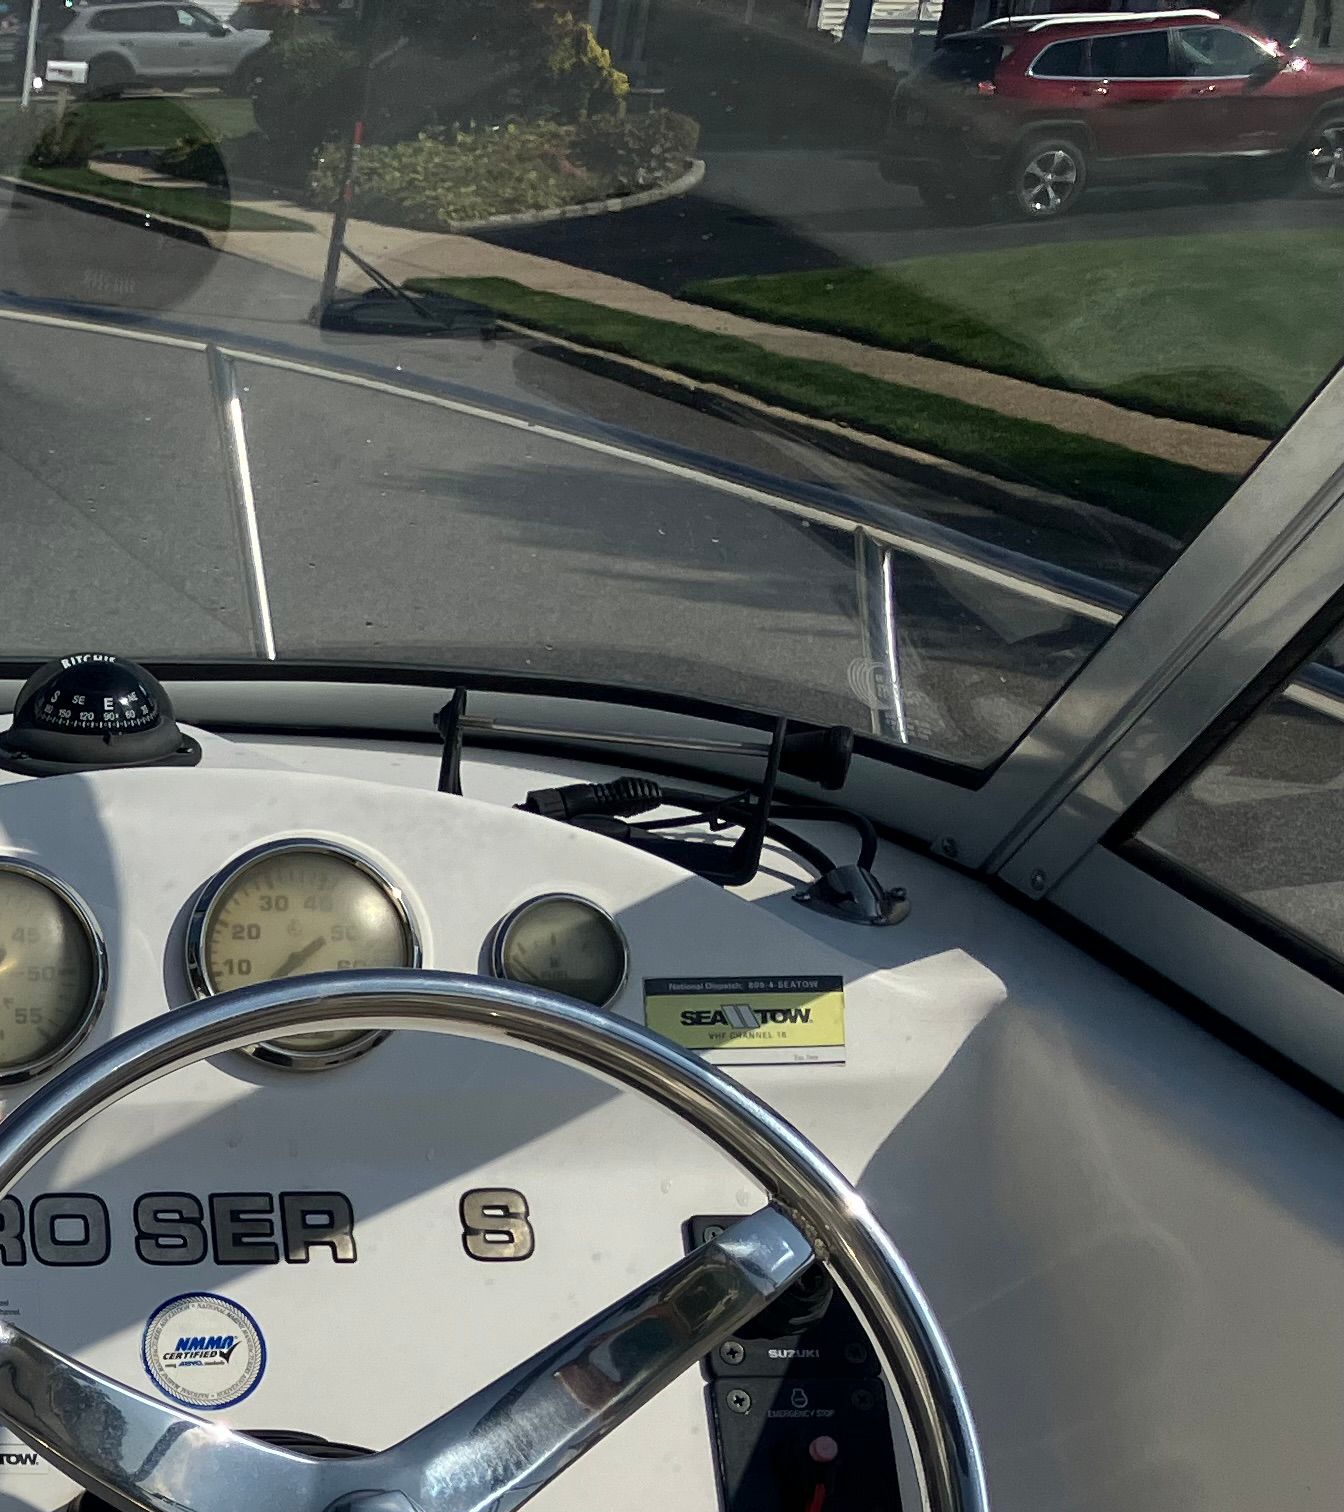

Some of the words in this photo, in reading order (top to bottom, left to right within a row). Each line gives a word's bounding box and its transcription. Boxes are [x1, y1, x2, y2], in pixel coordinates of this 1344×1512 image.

[51, 690, 61, 703] S
[72, 694, 86, 705] SE
[103, 697, 114, 710] E
[79, 712, 94, 720] 120
[259, 895, 289, 912] 30
[13, 928, 41, 945] 45
[231, 923, 261, 941] 20
[26, 965, 56, 982] 50
[225, 959, 252, 975] 10
[14, 1007, 44, 1025] 55
[680, 1009, 729, 1026] SEA
[754, 1008, 811, 1025] TOW
[708, 1031, 726, 1040] VHF
[729, 1030, 773, 1039] CHANNEL
[175, 1335, 234, 1351] NMMA
[163, 1350, 217, 1361] CERTIFIED
[768, 1349, 819, 1359] SUZUKI
